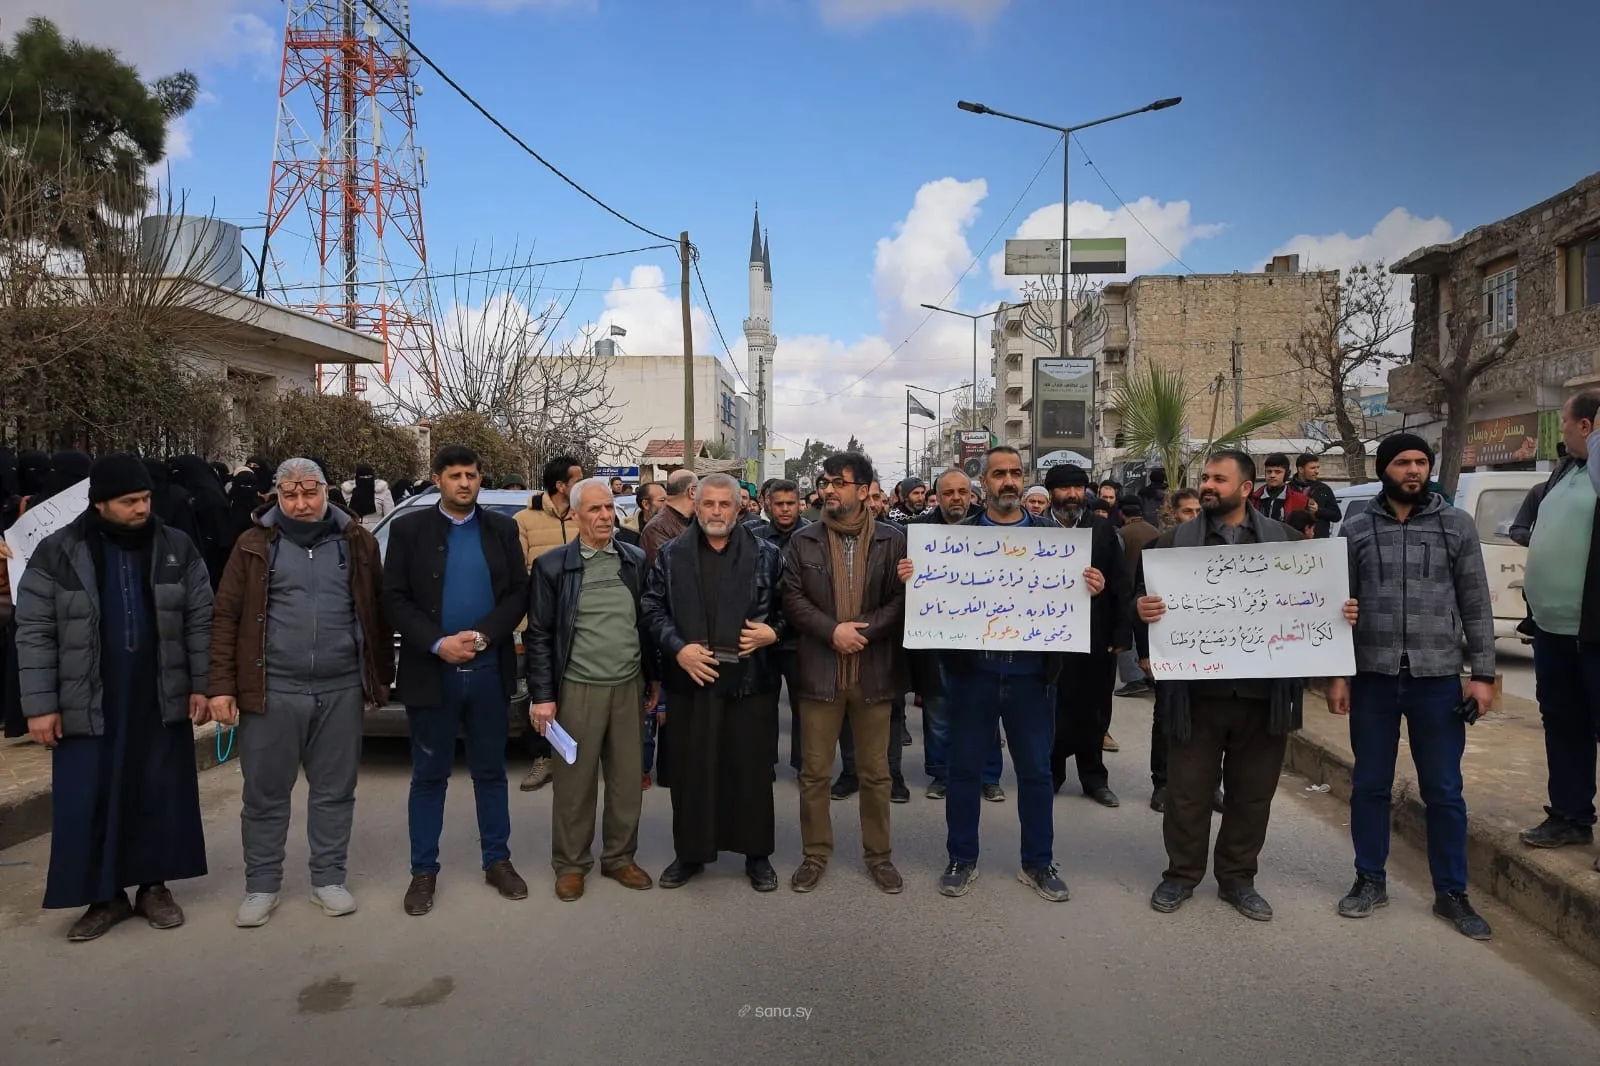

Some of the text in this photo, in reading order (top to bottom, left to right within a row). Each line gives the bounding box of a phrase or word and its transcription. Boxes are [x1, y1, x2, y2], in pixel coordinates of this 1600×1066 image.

[924, 539, 937, 553] له
[973, 540, 1001, 557] لست
[1059, 543, 1075, 558] لا
[1027, 569, 1040, 594] في
[948, 595, 986, 621] القلوب
[1022, 627, 1042, 642] على
